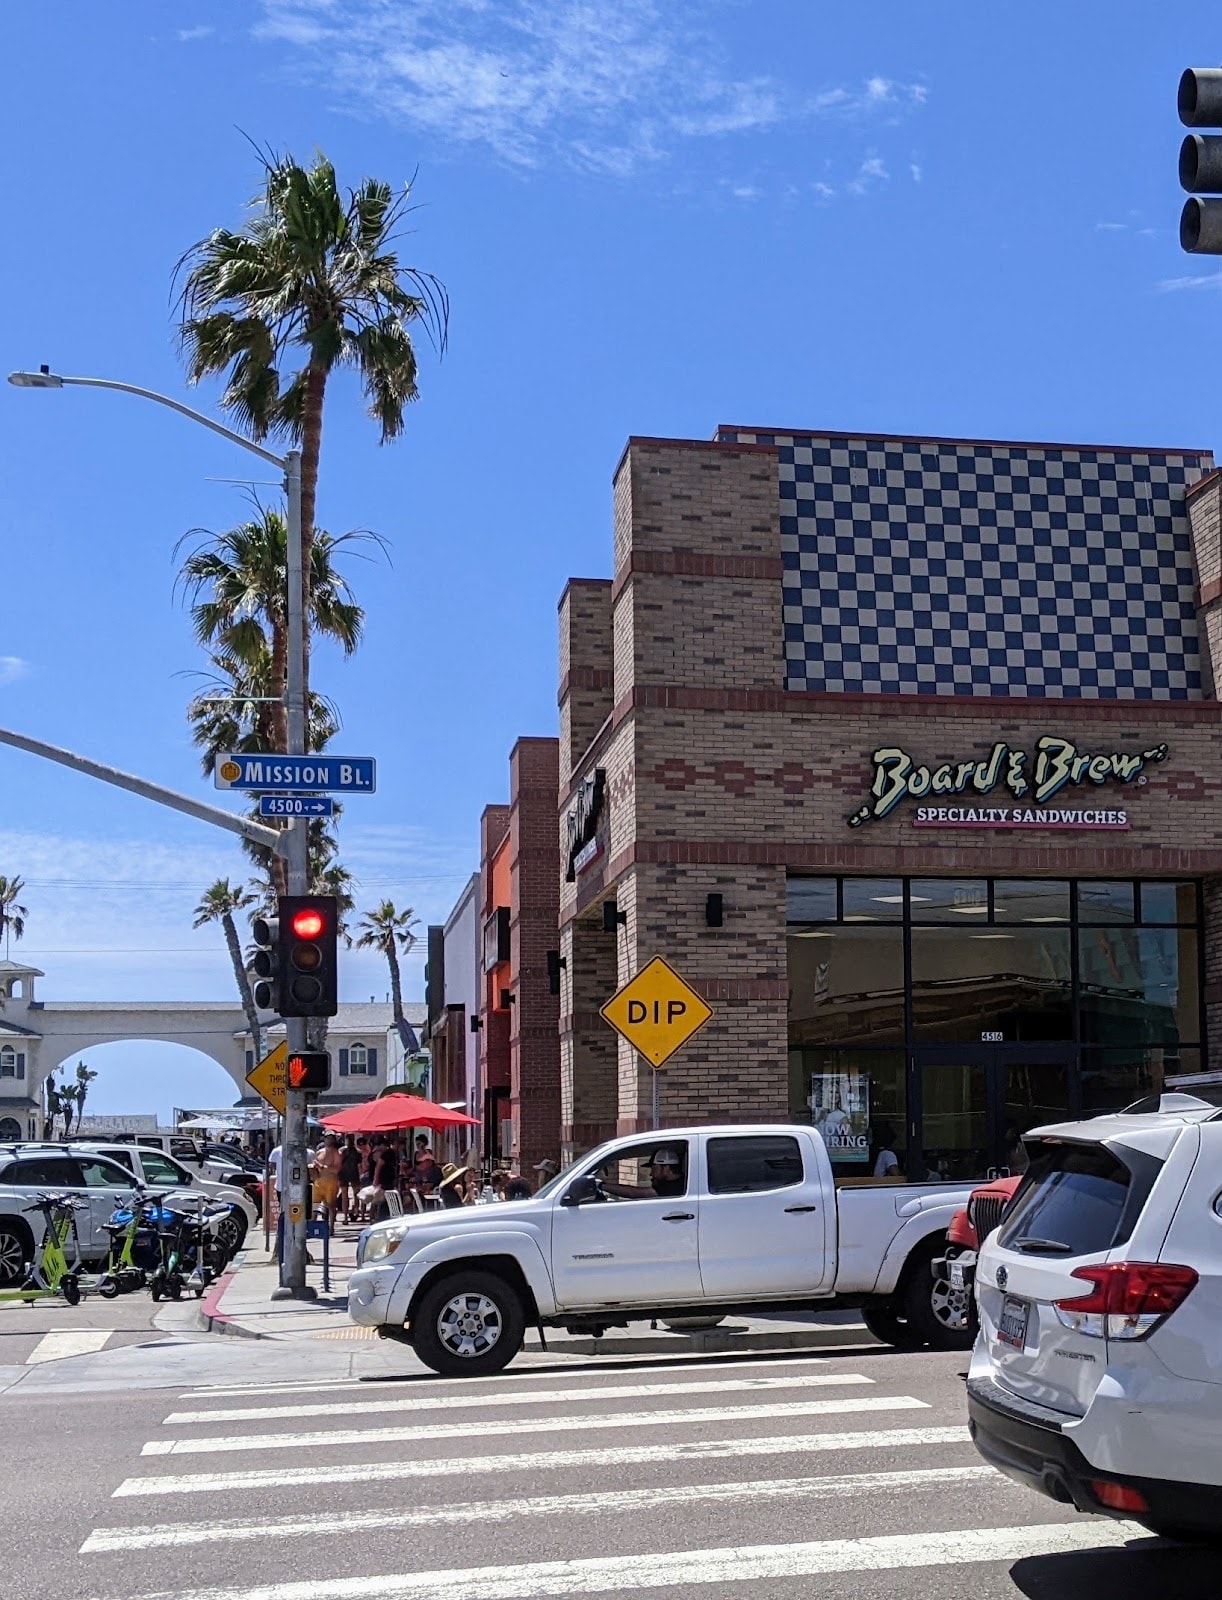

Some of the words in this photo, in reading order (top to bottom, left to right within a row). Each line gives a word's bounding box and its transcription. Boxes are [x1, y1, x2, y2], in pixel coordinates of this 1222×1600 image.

[244, 762, 329, 784] MISSION
[871, 742, 1007, 816] Board
[1008, 750, 1027, 797] &
[1035, 736, 1144, 803] Brew
[268, 799, 303, 814] 4500
[917, 808, 1009, 823] SPECIALTY
[1012, 809, 1127, 825] SANDWICHES
[627, 1000, 687, 1025] DIP
[982, 1032, 1003, 1041] 4516
[272, 1087, 285, 1096] STR
[826, 1135, 867, 1148] IRING
